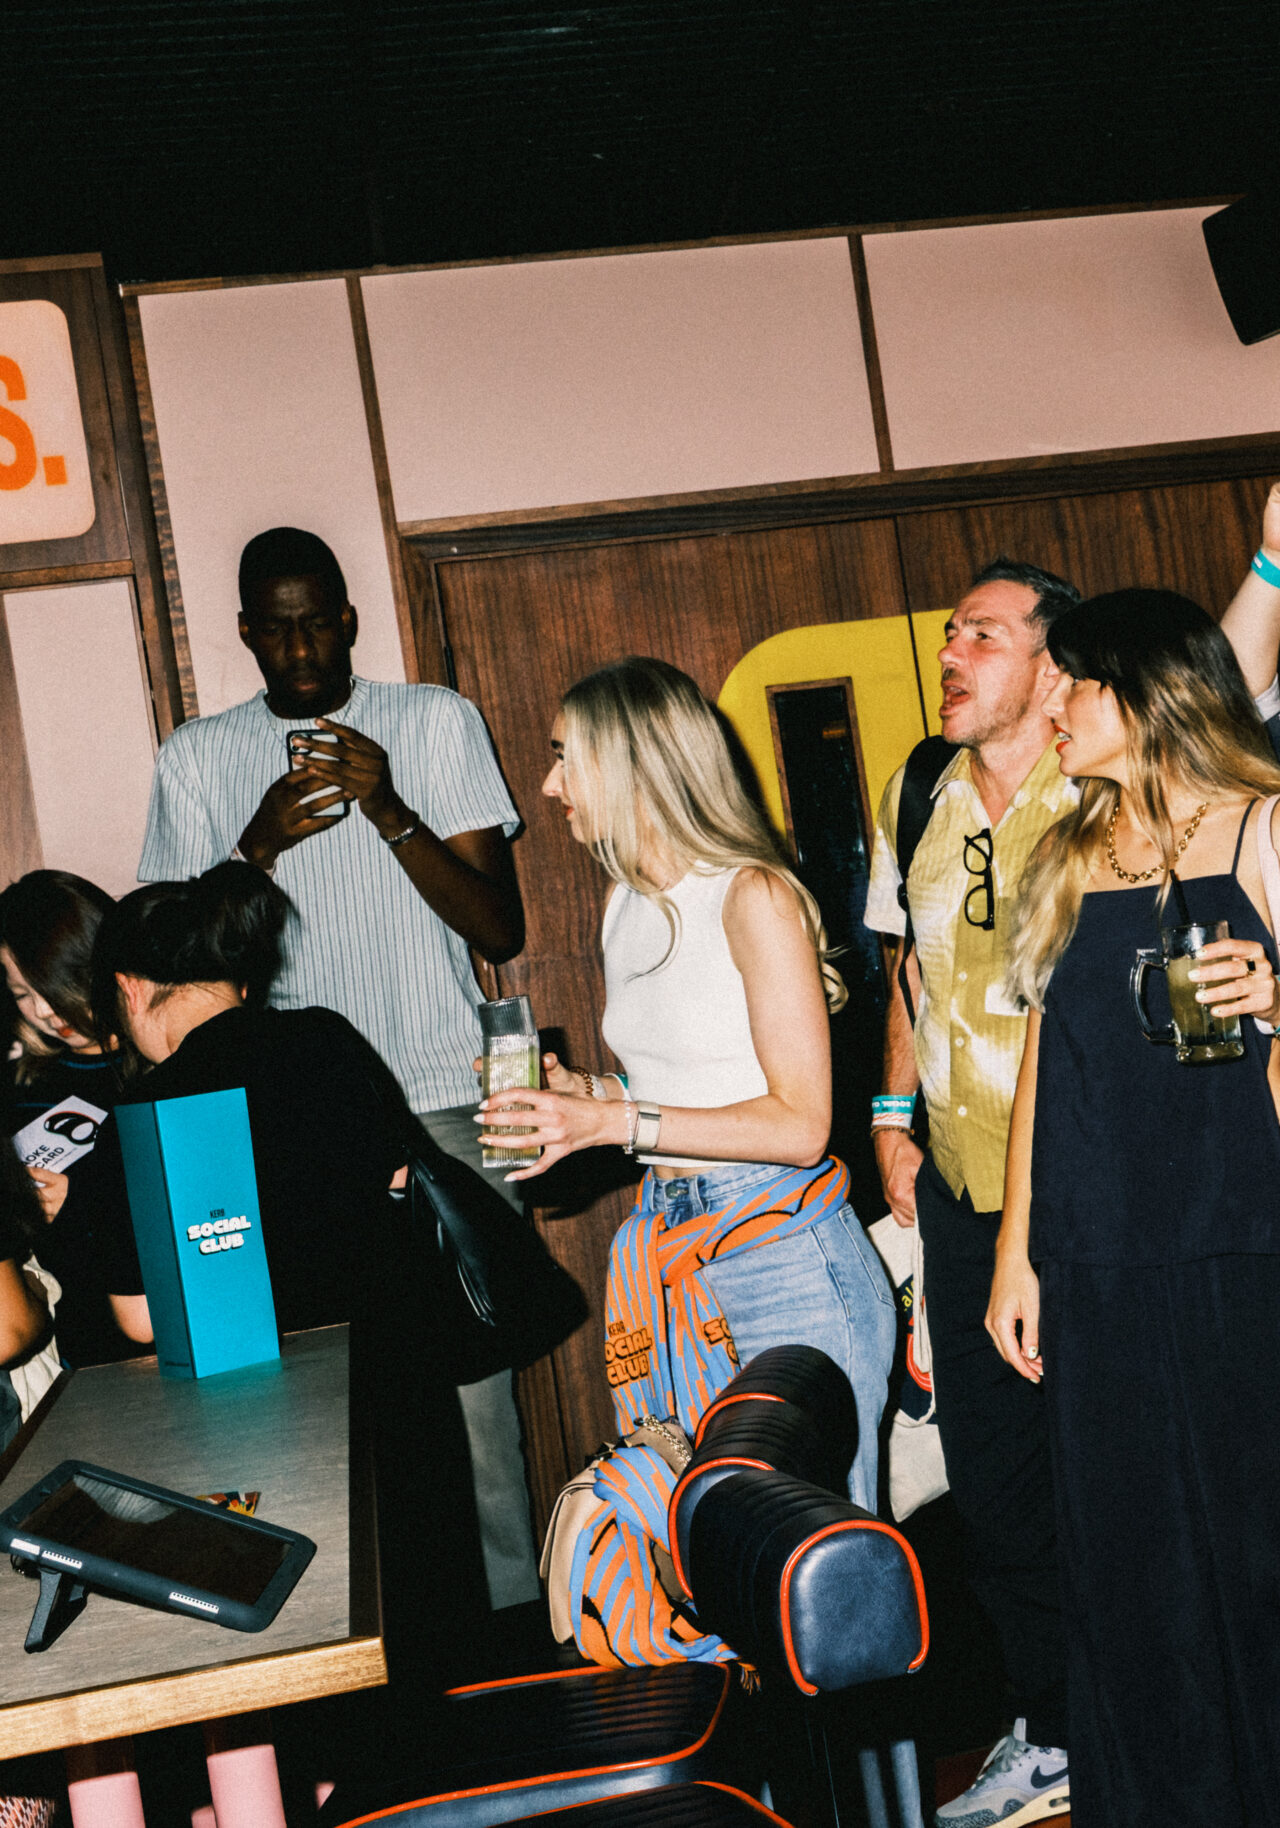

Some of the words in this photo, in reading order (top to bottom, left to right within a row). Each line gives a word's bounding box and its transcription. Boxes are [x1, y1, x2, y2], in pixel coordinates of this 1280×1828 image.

[187, 1215, 252, 1242] SOCIAL
[199, 1233, 245, 1255] CLUB
[604, 1327, 652, 1364] OCIAL
[606, 1353, 649, 1389] CLUB
